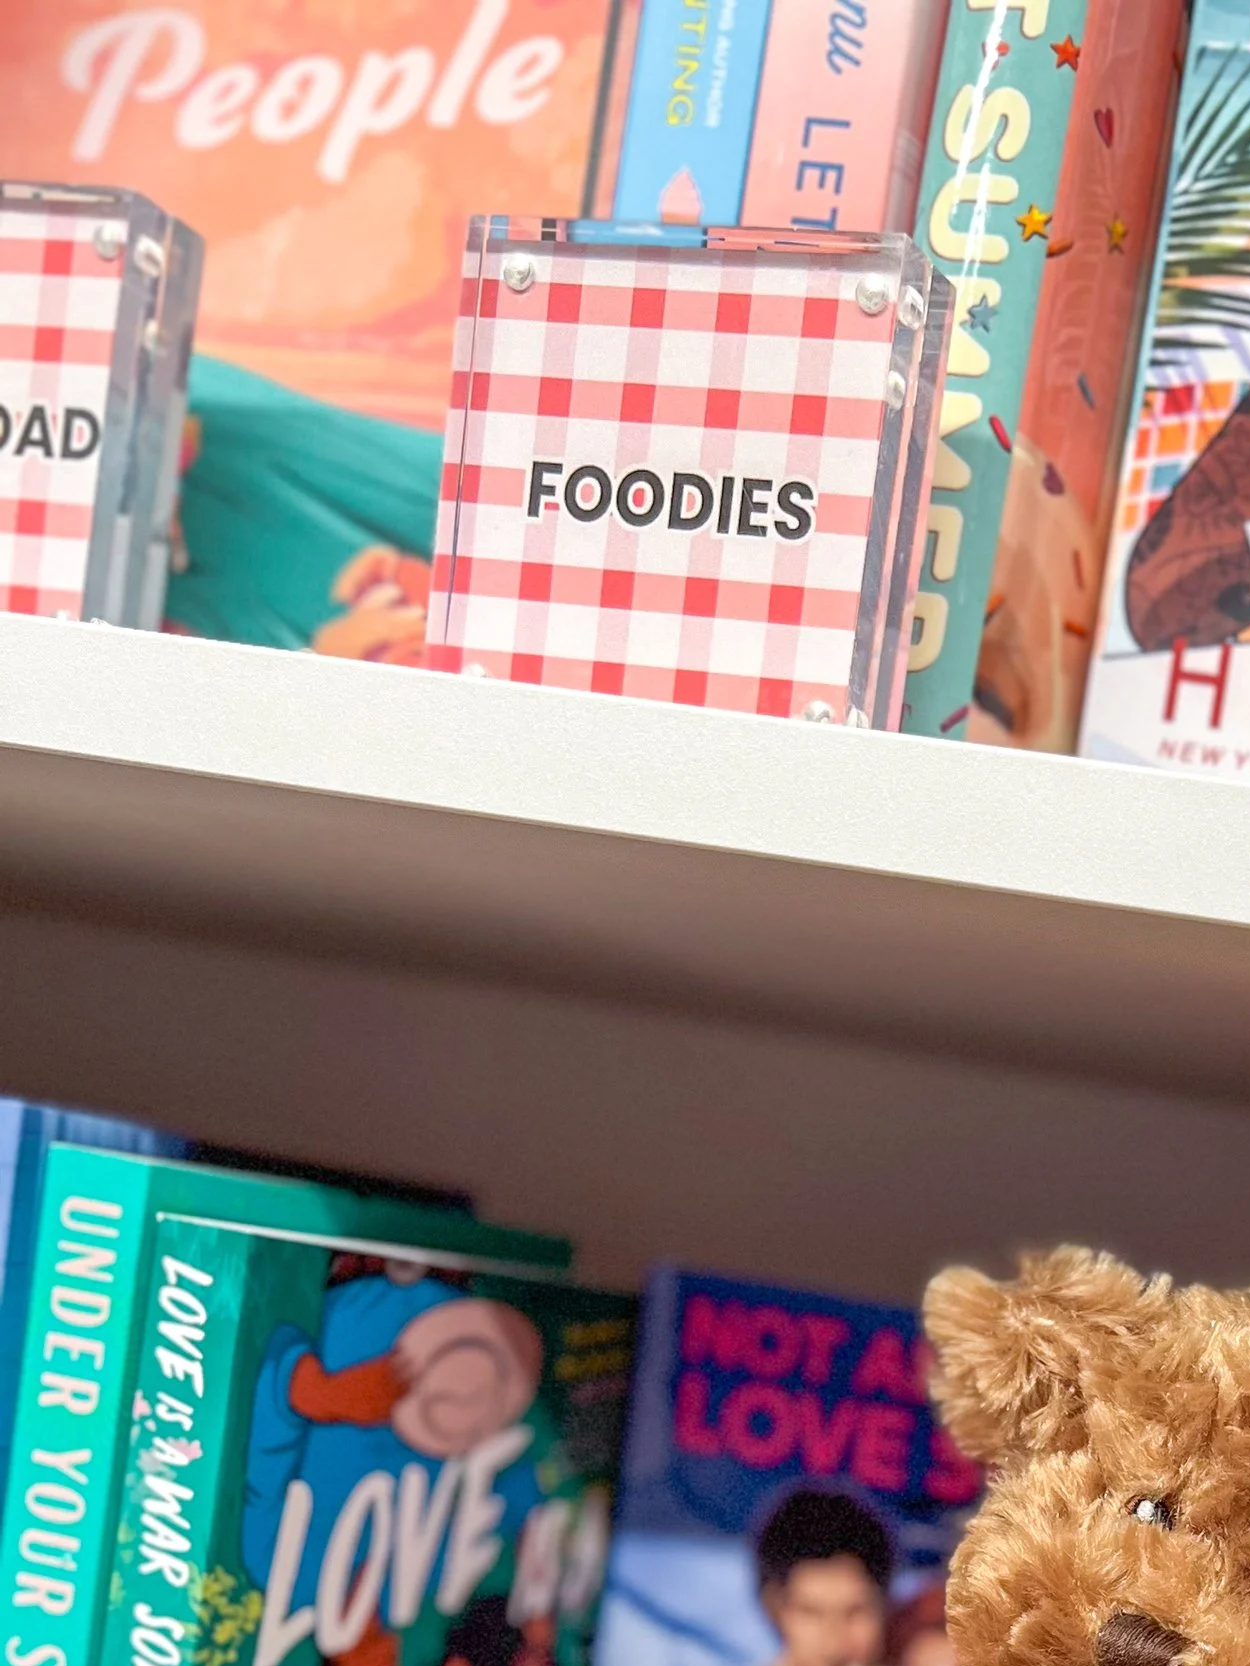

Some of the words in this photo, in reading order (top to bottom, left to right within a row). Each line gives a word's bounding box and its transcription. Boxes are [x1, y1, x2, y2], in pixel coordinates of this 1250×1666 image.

[60, 0, 566, 184] People
[0, 403, 101, 461] AD
[527, 461, 816, 540] FOODIES
[1156, 736, 1227, 768] NEW
[36, 1194, 124, 1416] UNDER
[155, 1254, 214, 1398] LOVE
[681, 1293, 850, 1387] NOT
[152, 1437, 190, 1468] A
[156, 1392, 193, 1431] IS
[674, 1371, 918, 1490] LOVE
[11, 1447, 93, 1617] YOUR
[138, 1471, 194, 1588] WAR
